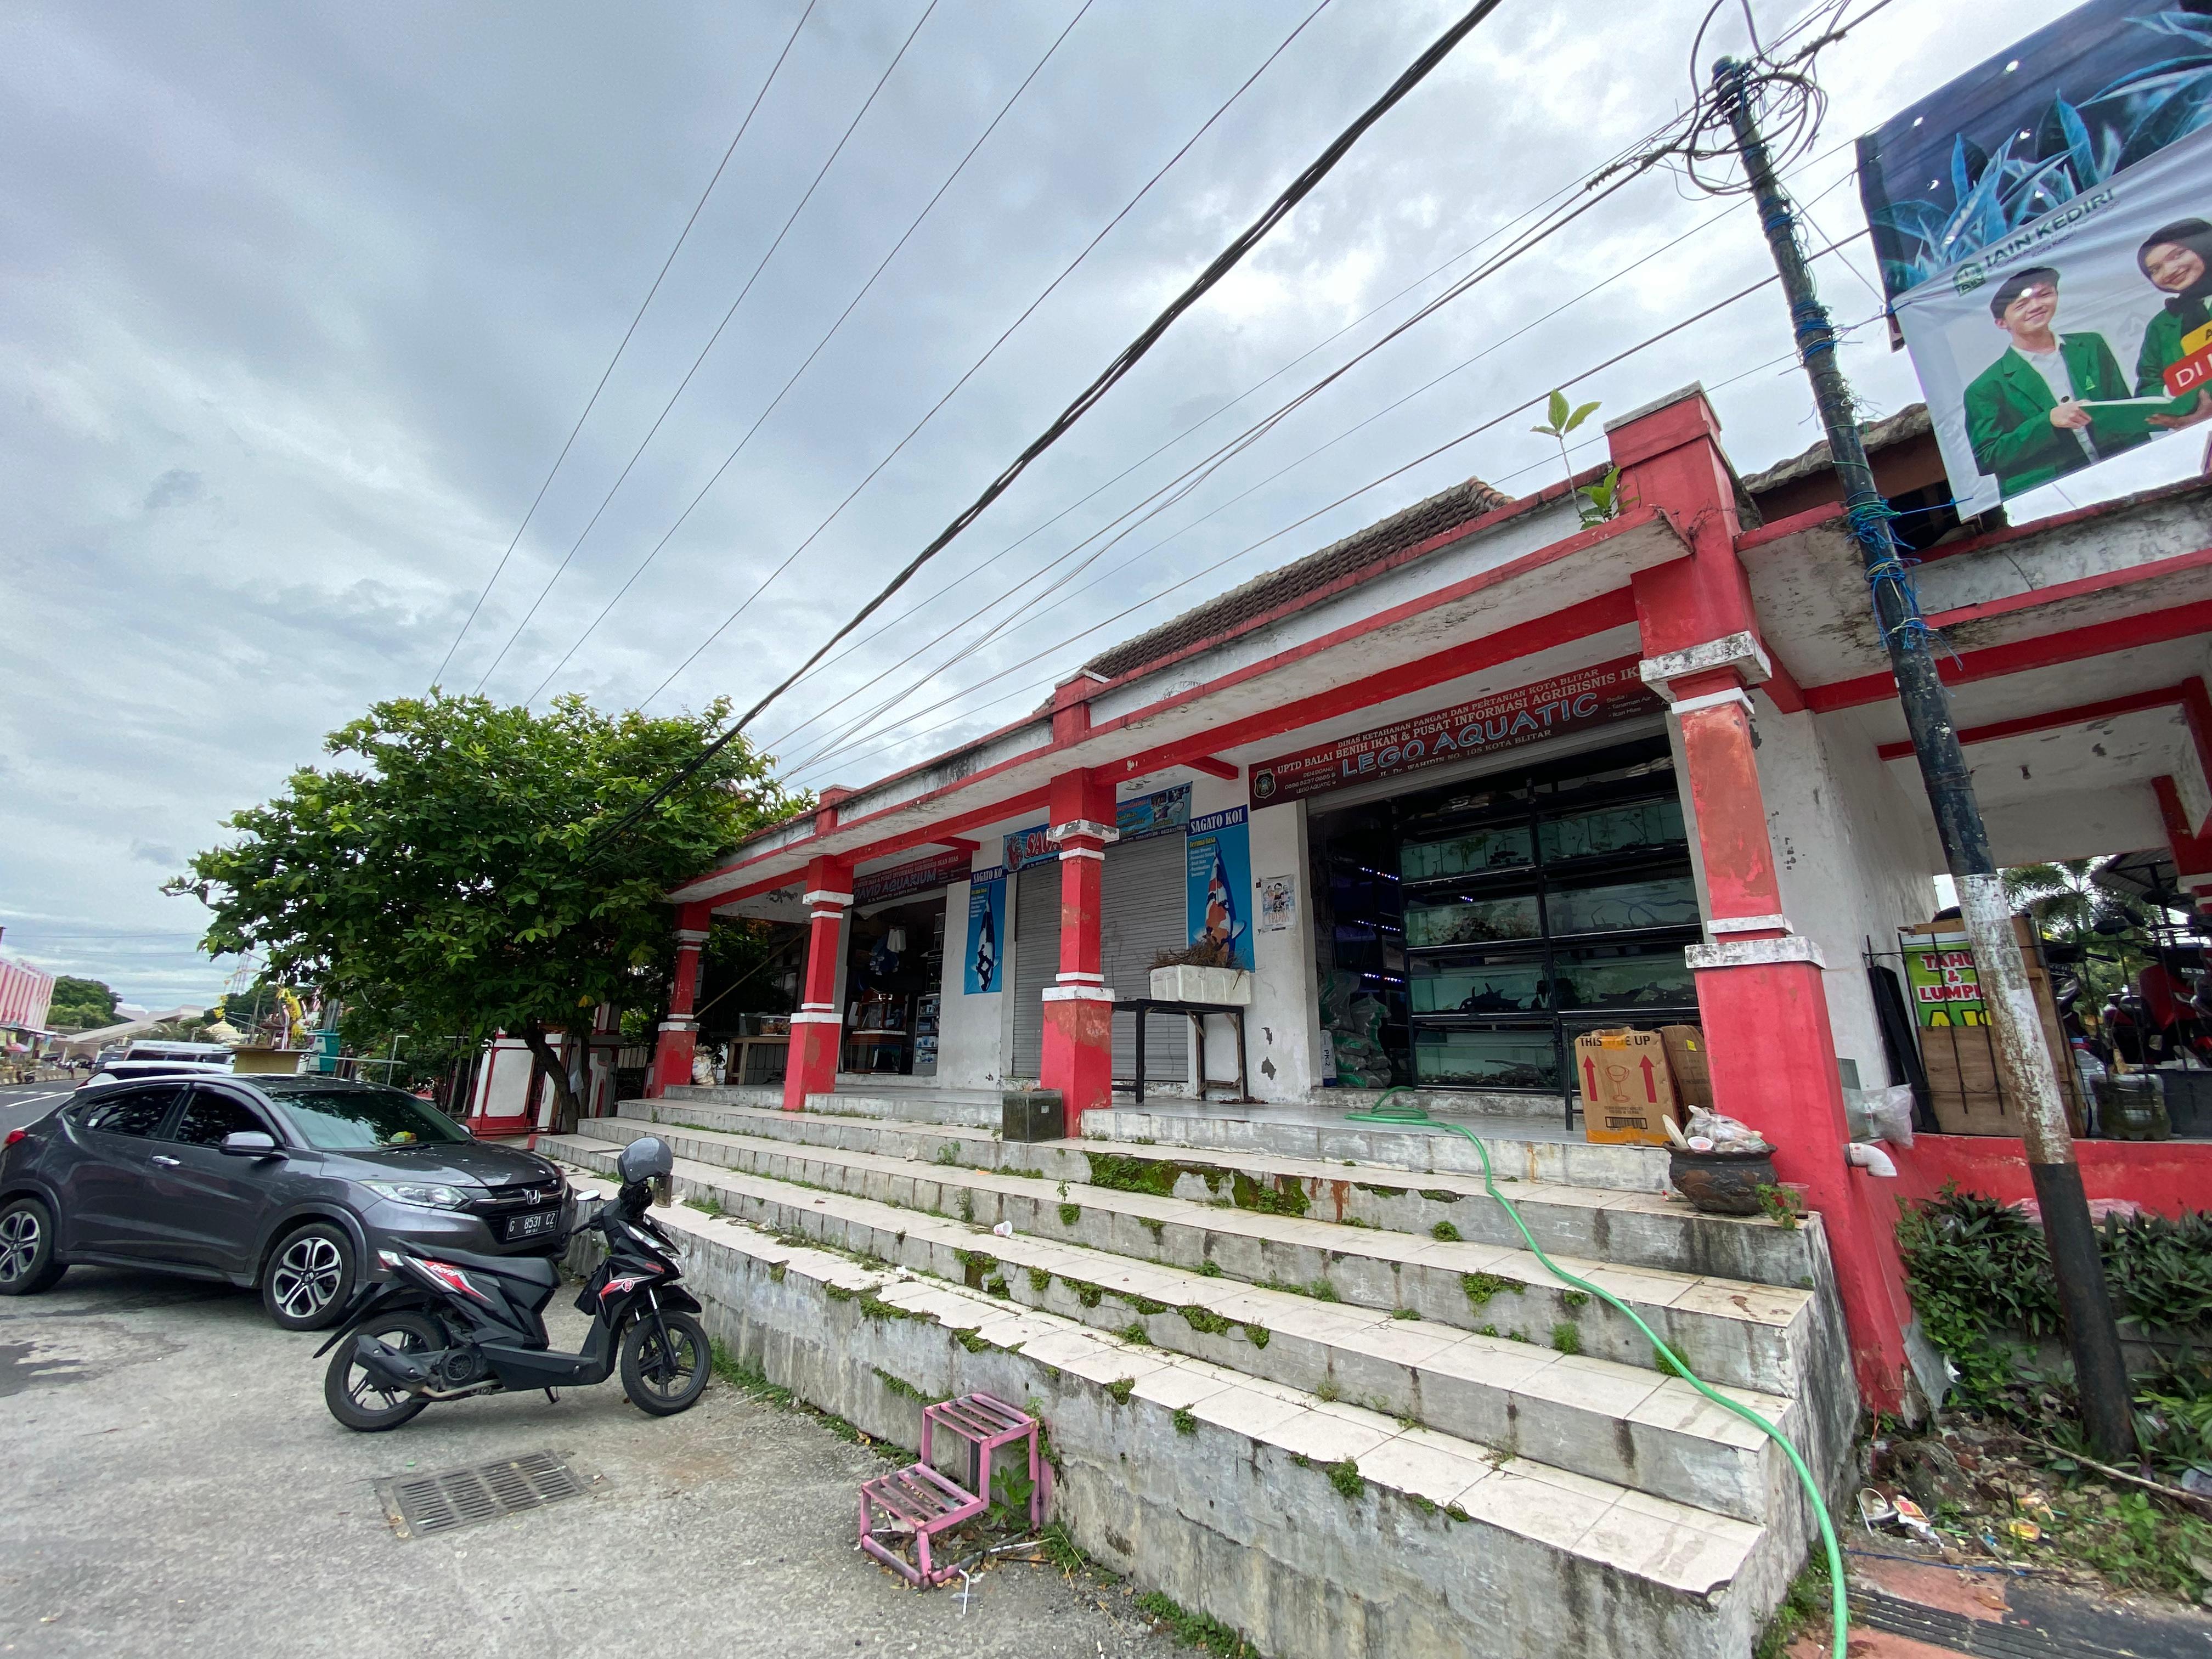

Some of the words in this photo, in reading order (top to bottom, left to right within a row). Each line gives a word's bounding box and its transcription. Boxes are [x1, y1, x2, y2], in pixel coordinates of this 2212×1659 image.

[1985, 233, 2031, 267] IAIN
[2035, 188, 2113, 239] KEDIRI
[2175, 362, 2203, 388] DI
[1277, 761, 1302, 774] UPTD
[1305, 752, 1333, 768] BALAI
[1336, 742, 1368, 758] BENIH
[1371, 733, 1398, 749] IKAN
[1401, 731, 1410, 741] &
[1413, 719, 1451, 738] PUSAT
[1454, 698, 1528, 726] INFORMASI
[1532, 673, 1616, 705] AGRIBISNIS
[1620, 665, 1640, 681] IK
[1338, 737, 1361, 748] DINAS
[1362, 723, 1411, 741] KETAHANAN
[1413, 712, 1448, 728] PANGAN
[1451, 706, 1469, 716] DAN
[1471, 689, 1526, 710] PERTANIAN
[1528, 681, 1557, 695] KOTA
[1560, 669, 1599, 686] BLITAR
[1342, 739, 1425, 777] LEGO
[1431, 692, 1599, 755] AQUATIC
[1407, 757, 1445, 771] WAHIDIN
[1466, 747, 1482, 755] 105
[1485, 738, 1513, 751] KOTA
[1515, 729, 1552, 743] BLITAR
[1296, 786, 1309, 794] LEGO
[1309, 781, 1331, 792] AQUATIC
[1190, 814, 1223, 834] SAGATO
[1225, 809, 1243, 825] KOI
[854, 884, 881, 900] DAVID
[882, 868, 936, 893] AQUARIUM
[994, 868, 1003, 879] KO
[1922, 953, 1975, 969] TAHU
[1948, 970, 1959, 983] &
[1918, 984, 1982, 1001] LUMPI
[1579, 1037, 1602, 1047] THIS
[1634, 1035, 1651, 1046] UP
[524, 1215, 541, 1229] 8531
[545, 1212, 556, 1225] CZ
